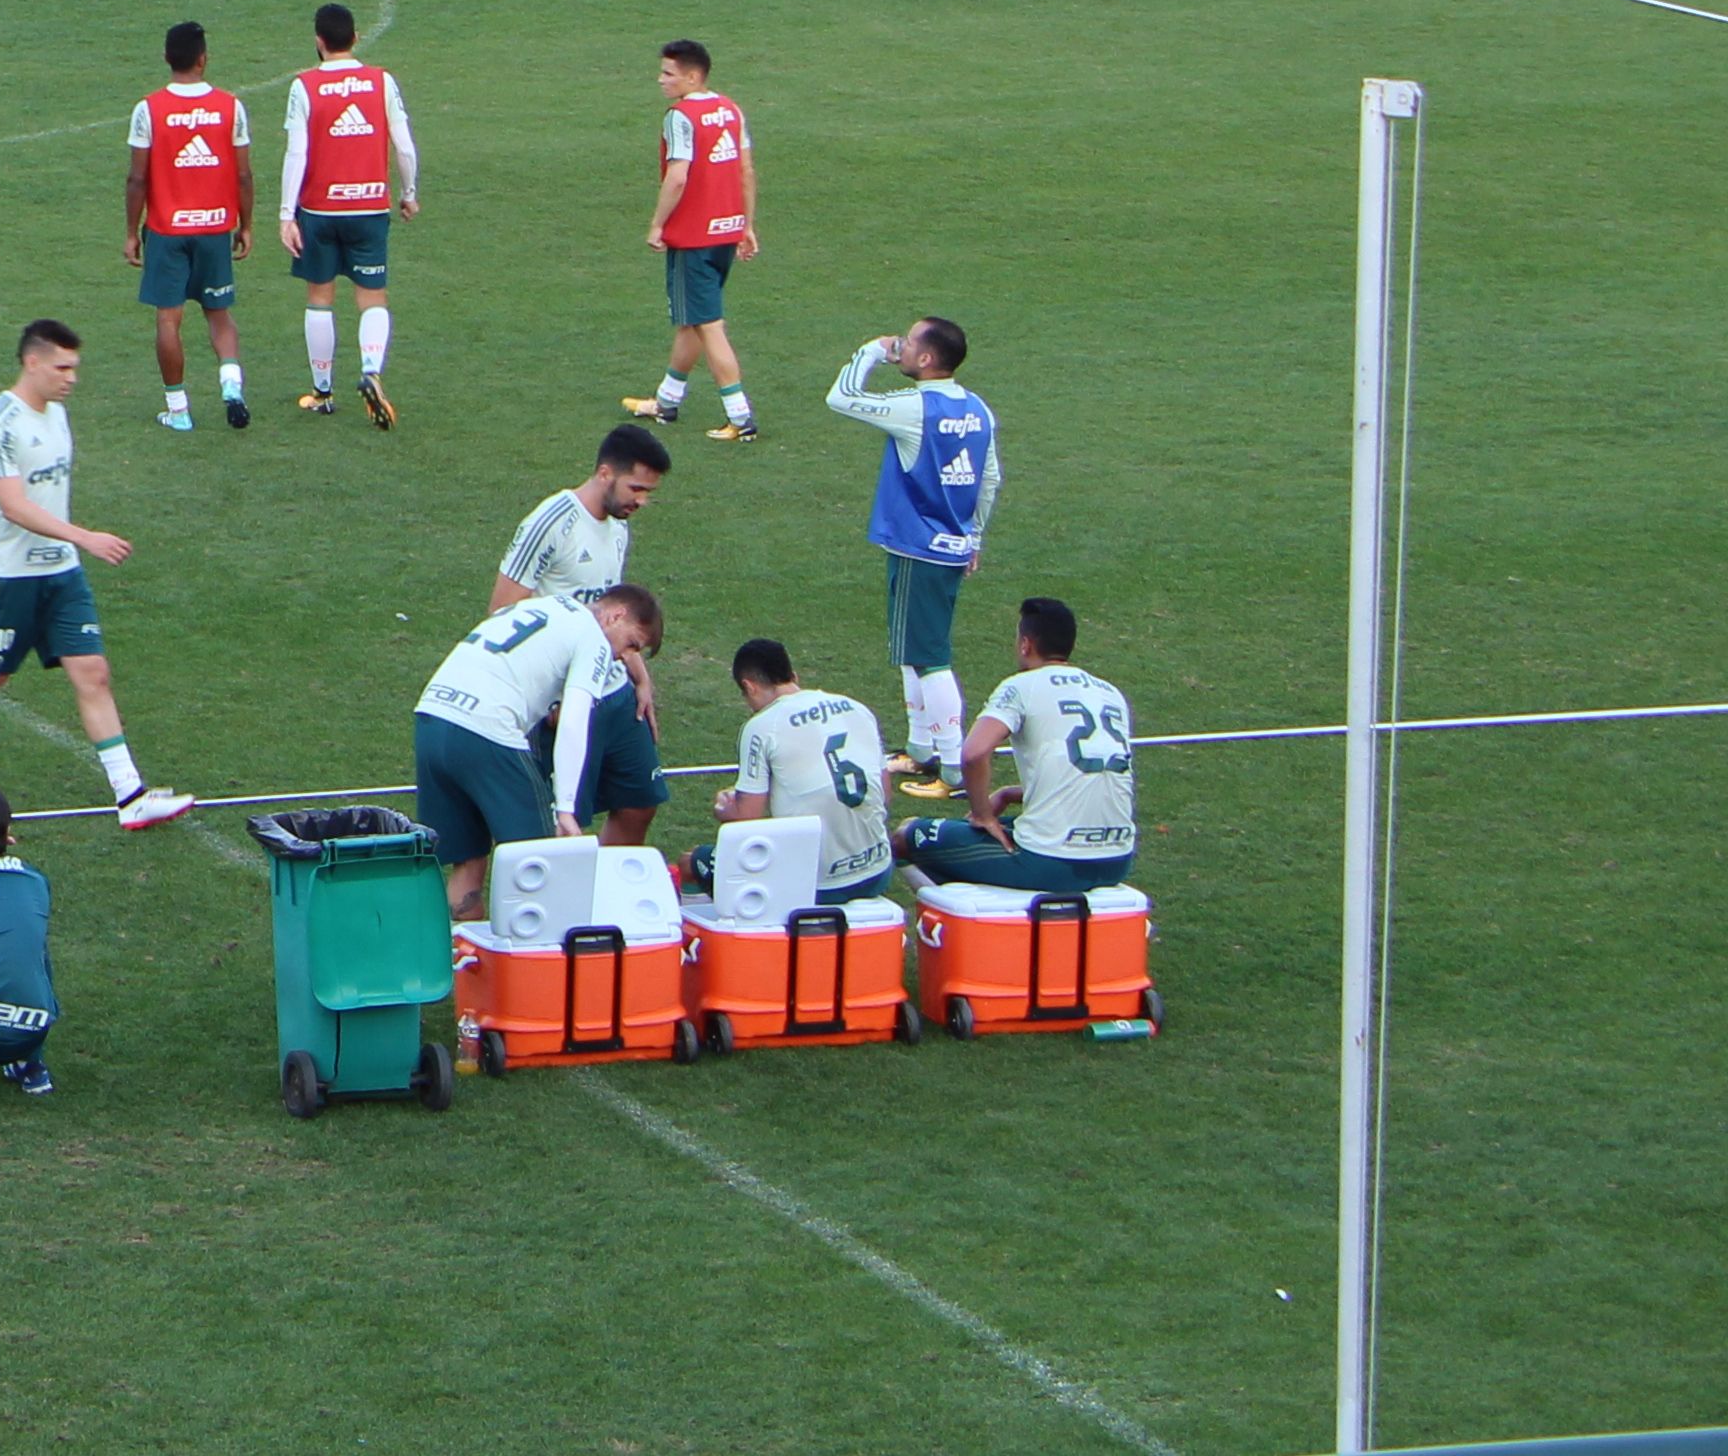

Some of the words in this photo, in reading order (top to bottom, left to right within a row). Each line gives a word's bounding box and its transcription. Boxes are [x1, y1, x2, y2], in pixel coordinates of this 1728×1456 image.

[319, 77, 374, 98] crefisa
[167, 108, 222, 129] crefisa
[329, 124, 374, 136] adidas
[174, 155, 220, 168] adidas
[789, 699, 855, 728] crefisa
[1058, 700, 1132, 774] 25
[823, 731, 869, 808] 6
